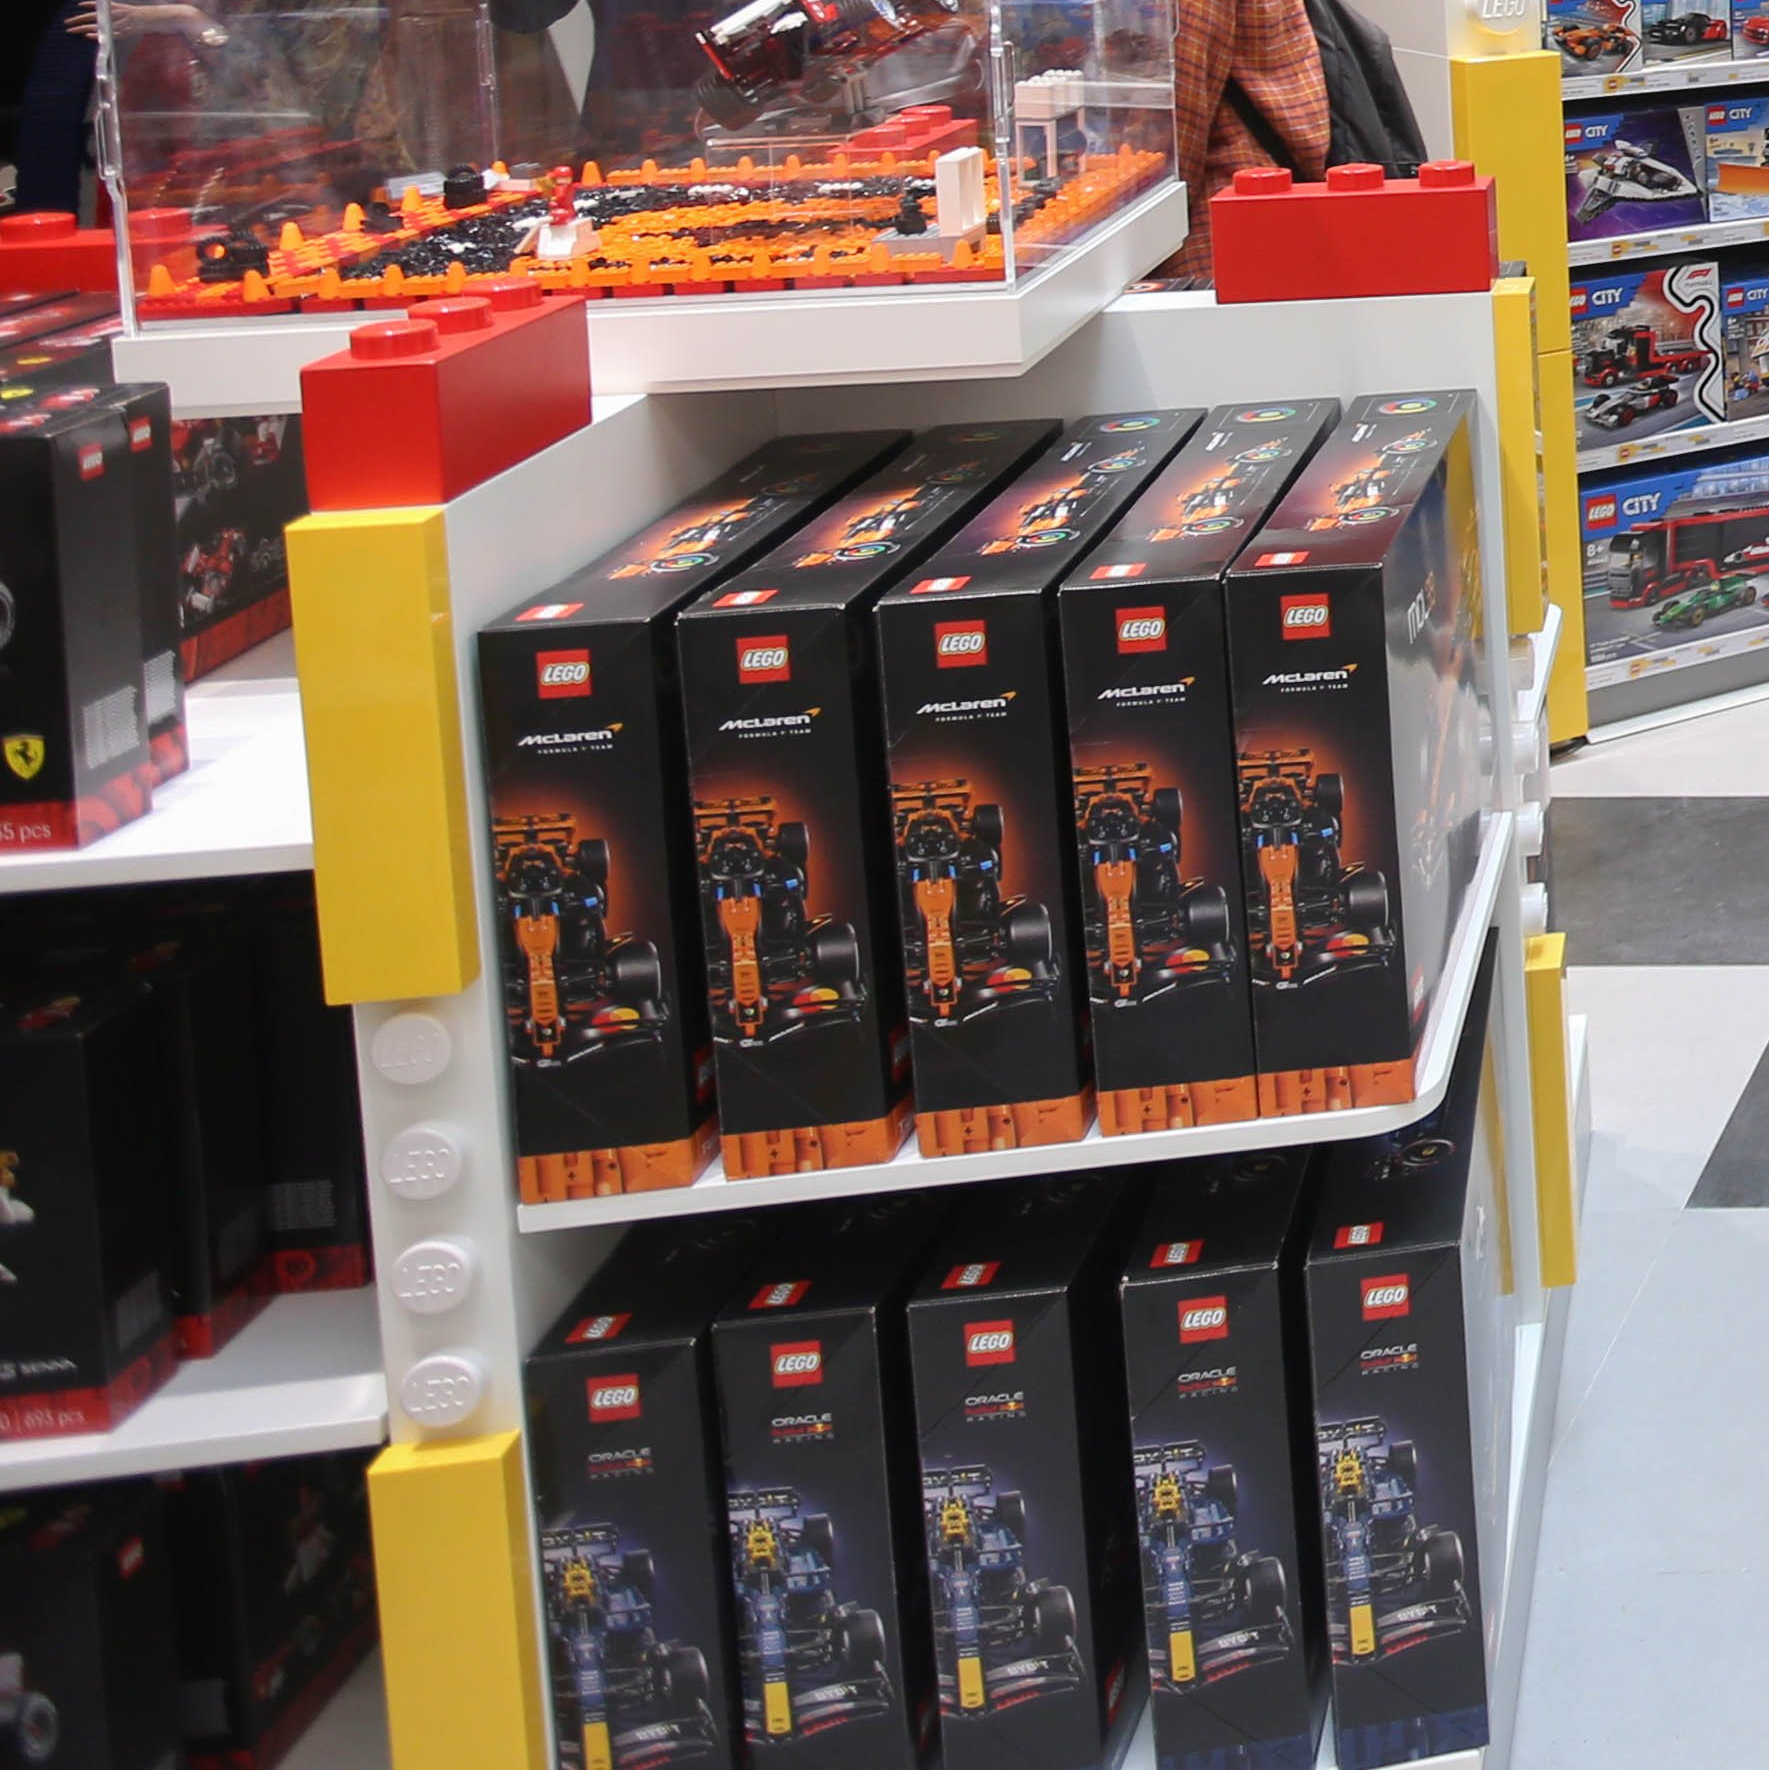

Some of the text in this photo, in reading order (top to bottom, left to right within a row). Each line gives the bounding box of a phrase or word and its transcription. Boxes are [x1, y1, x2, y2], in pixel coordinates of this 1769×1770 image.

[1729, 107, 1753, 121] CITY
[1585, 125, 1608, 138] CITY
[1592, 288, 1623, 307] CITY
[1747, 289, 1769, 301] CITY
[1587, 492, 1661, 522] LEGO CITY
[1586, 543, 1604, 558] 8+
[1283, 605, 1327, 628] LEGO
[1119, 618, 1163, 641] LEGO
[940, 631, 985, 654] LEGO
[741, 647, 788, 670] LEGO
[540, 662, 589, 686] LEGO
[1261, 669, 1348, 686] McLaren
[1096, 682, 1186, 700] McLaren
[1326, 682, 1349, 690] TEAM
[916, 697, 1007, 715] McLaren
[1163, 695, 1187, 704] TEAM
[718, 713, 812, 731] McLaren
[983, 710, 1008, 719] TEAM
[517, 729, 613, 747] McLaren
[787, 727, 813, 736] TEAM
[589, 742, 614, 751] TEAM
[18, 823, 52, 844] pcs
[1367, 1287, 1407, 1306] LEGO
[1183, 1309, 1223, 1329] LEGO
[971, 1332, 1011, 1351] LEGO
[1360, 1343, 1418, 1360] ORACLE
[777, 1353, 819, 1373] LEGO
[1178, 1366, 1237, 1383] ORACLE
[593, 1386, 637, 1408] LEGO
[965, 1391, 1025, 1407] ORACLE
[58, 1411, 86, 1430] pcs
[771, 1412, 833, 1428] ORACLE
[588, 1447, 652, 1463] ORACLE
